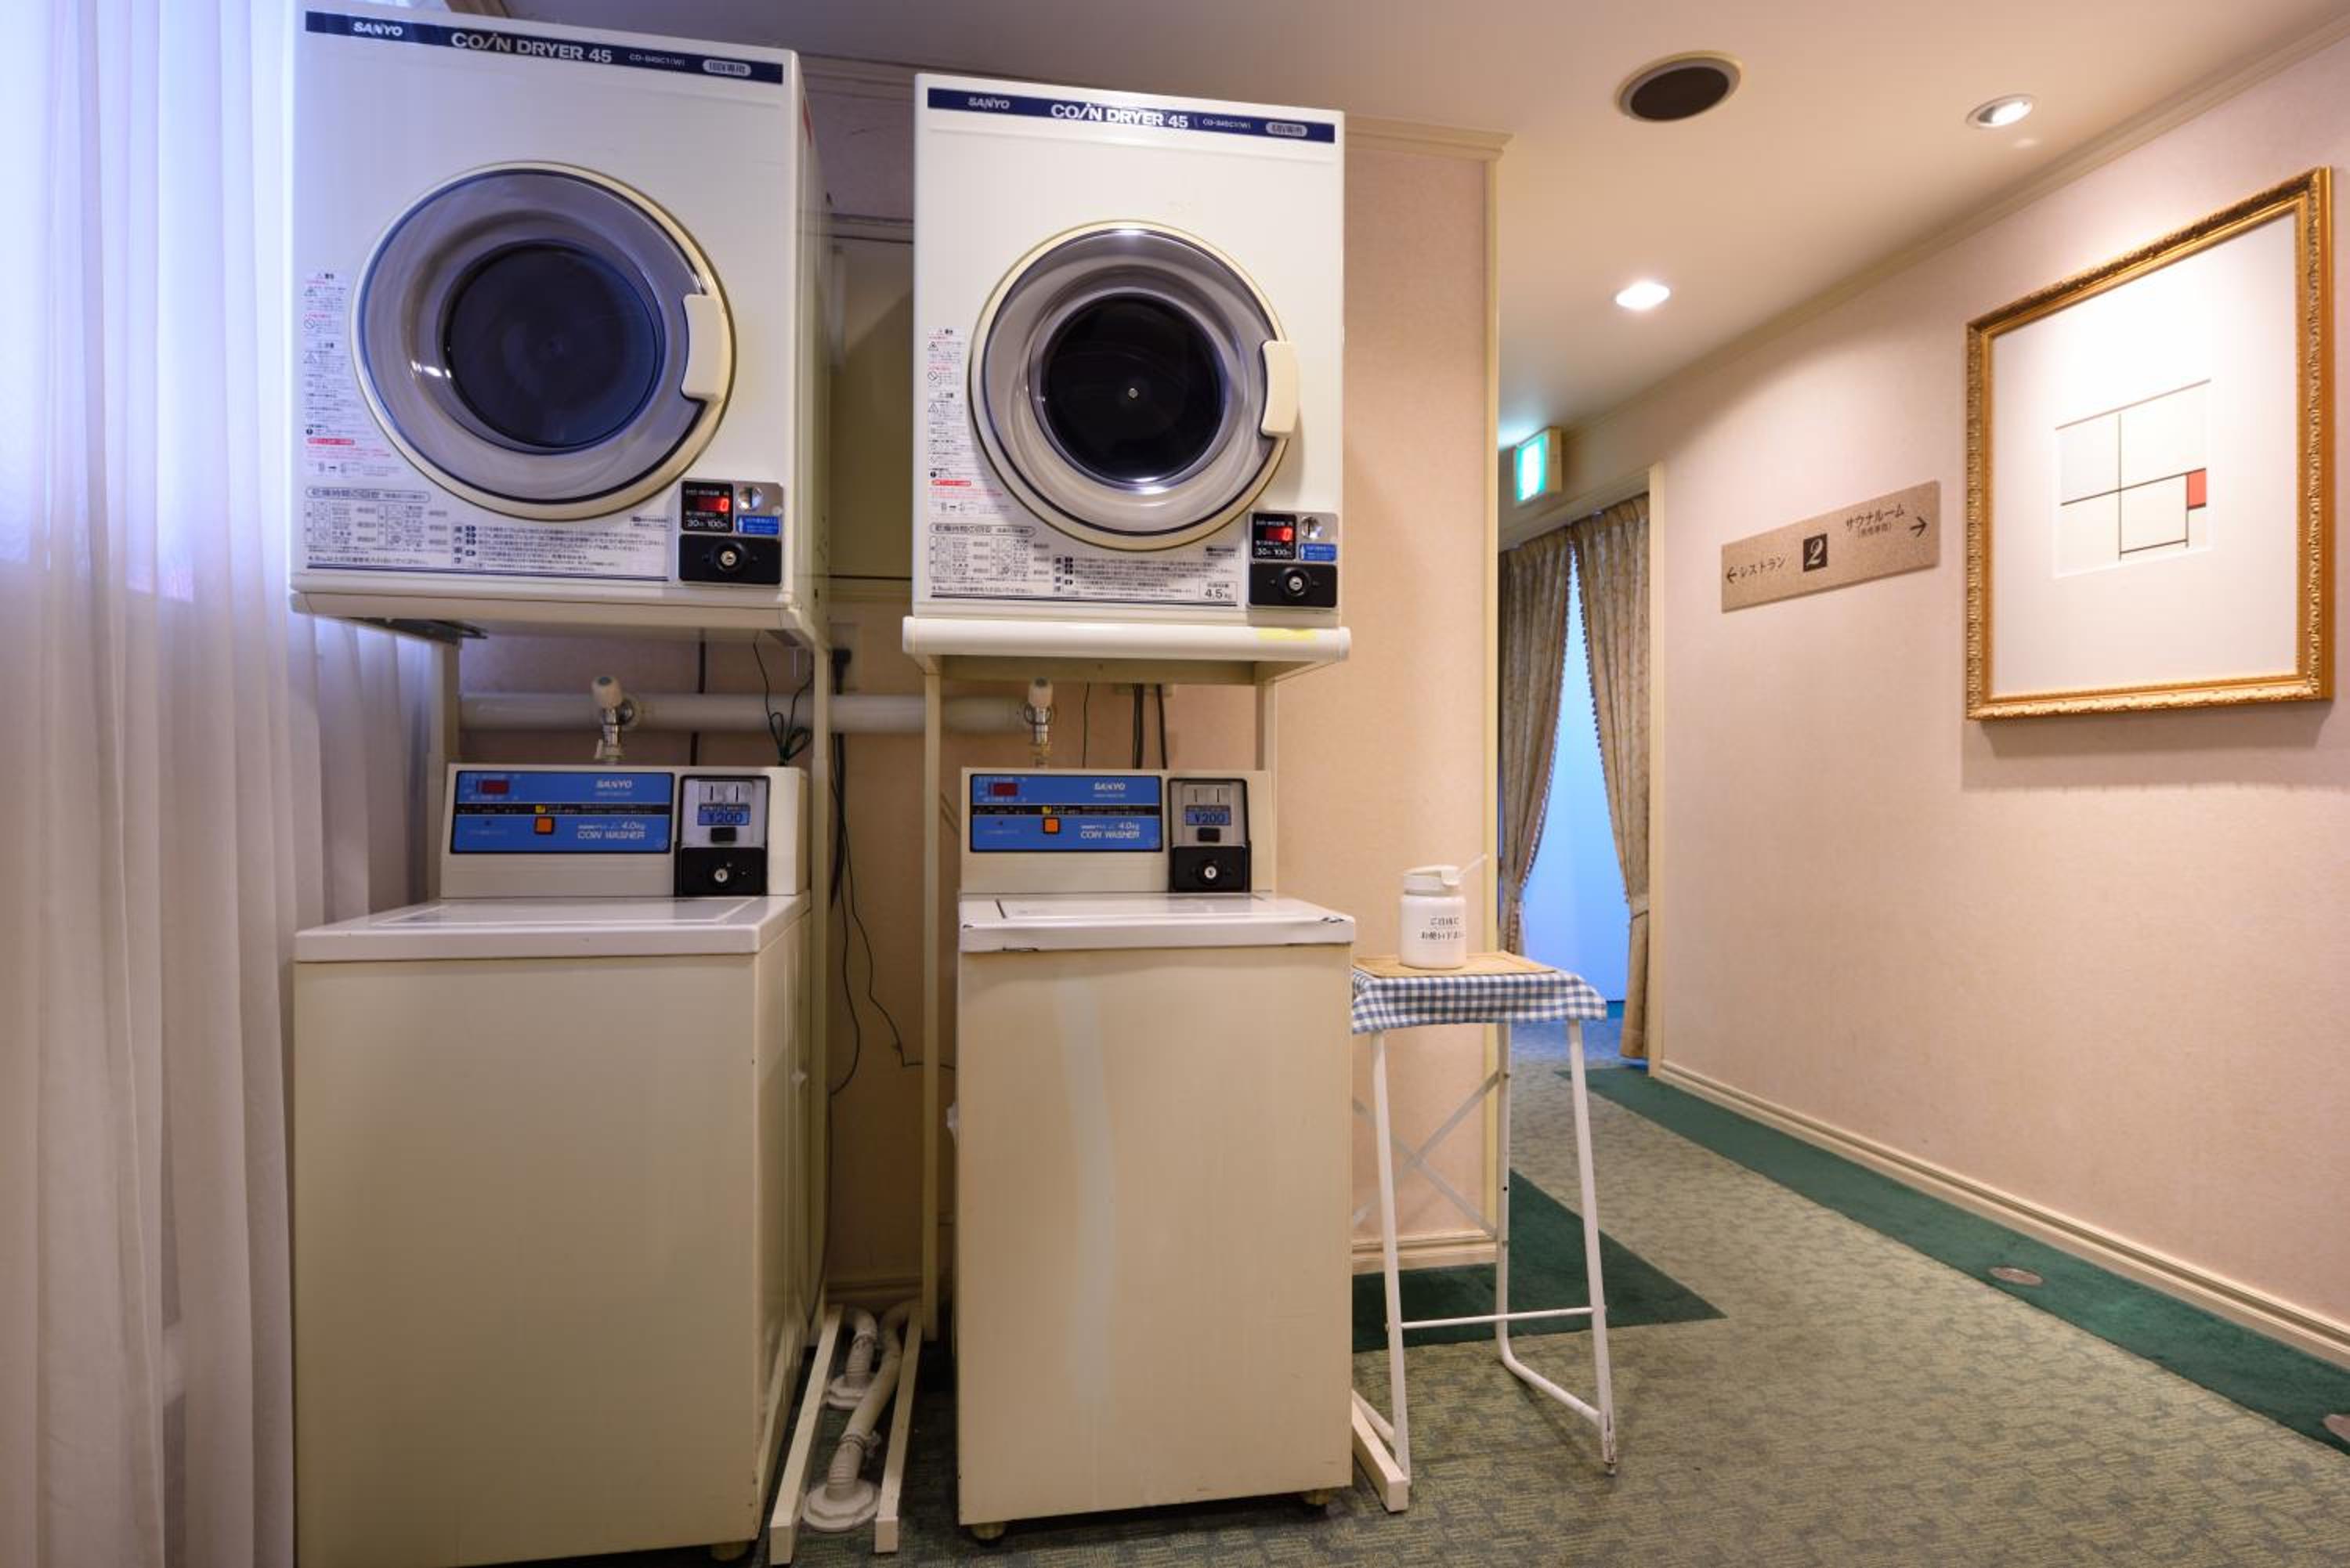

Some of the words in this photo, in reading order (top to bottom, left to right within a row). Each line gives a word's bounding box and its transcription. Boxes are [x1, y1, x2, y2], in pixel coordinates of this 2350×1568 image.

[353, 21, 403, 37] SANYO
[516, 39, 583, 60] DRYER
[588, 48, 613, 63] 45
[967, 96, 1010, 110] SANYO
[1107, 109, 1164, 127] DRYER
[1168, 114, 1189, 129] 45
[720, 497, 730, 512] 0
[1846, 503, 1905, 533] サウナルーム
[1282, 527, 1292, 541] 0
[1805, 537, 1824, 566] 2
[1739, 555, 1787, 578] レストラン
[596, 779, 633, 789] SANYO
[1094, 782, 1127, 791] SANYO
